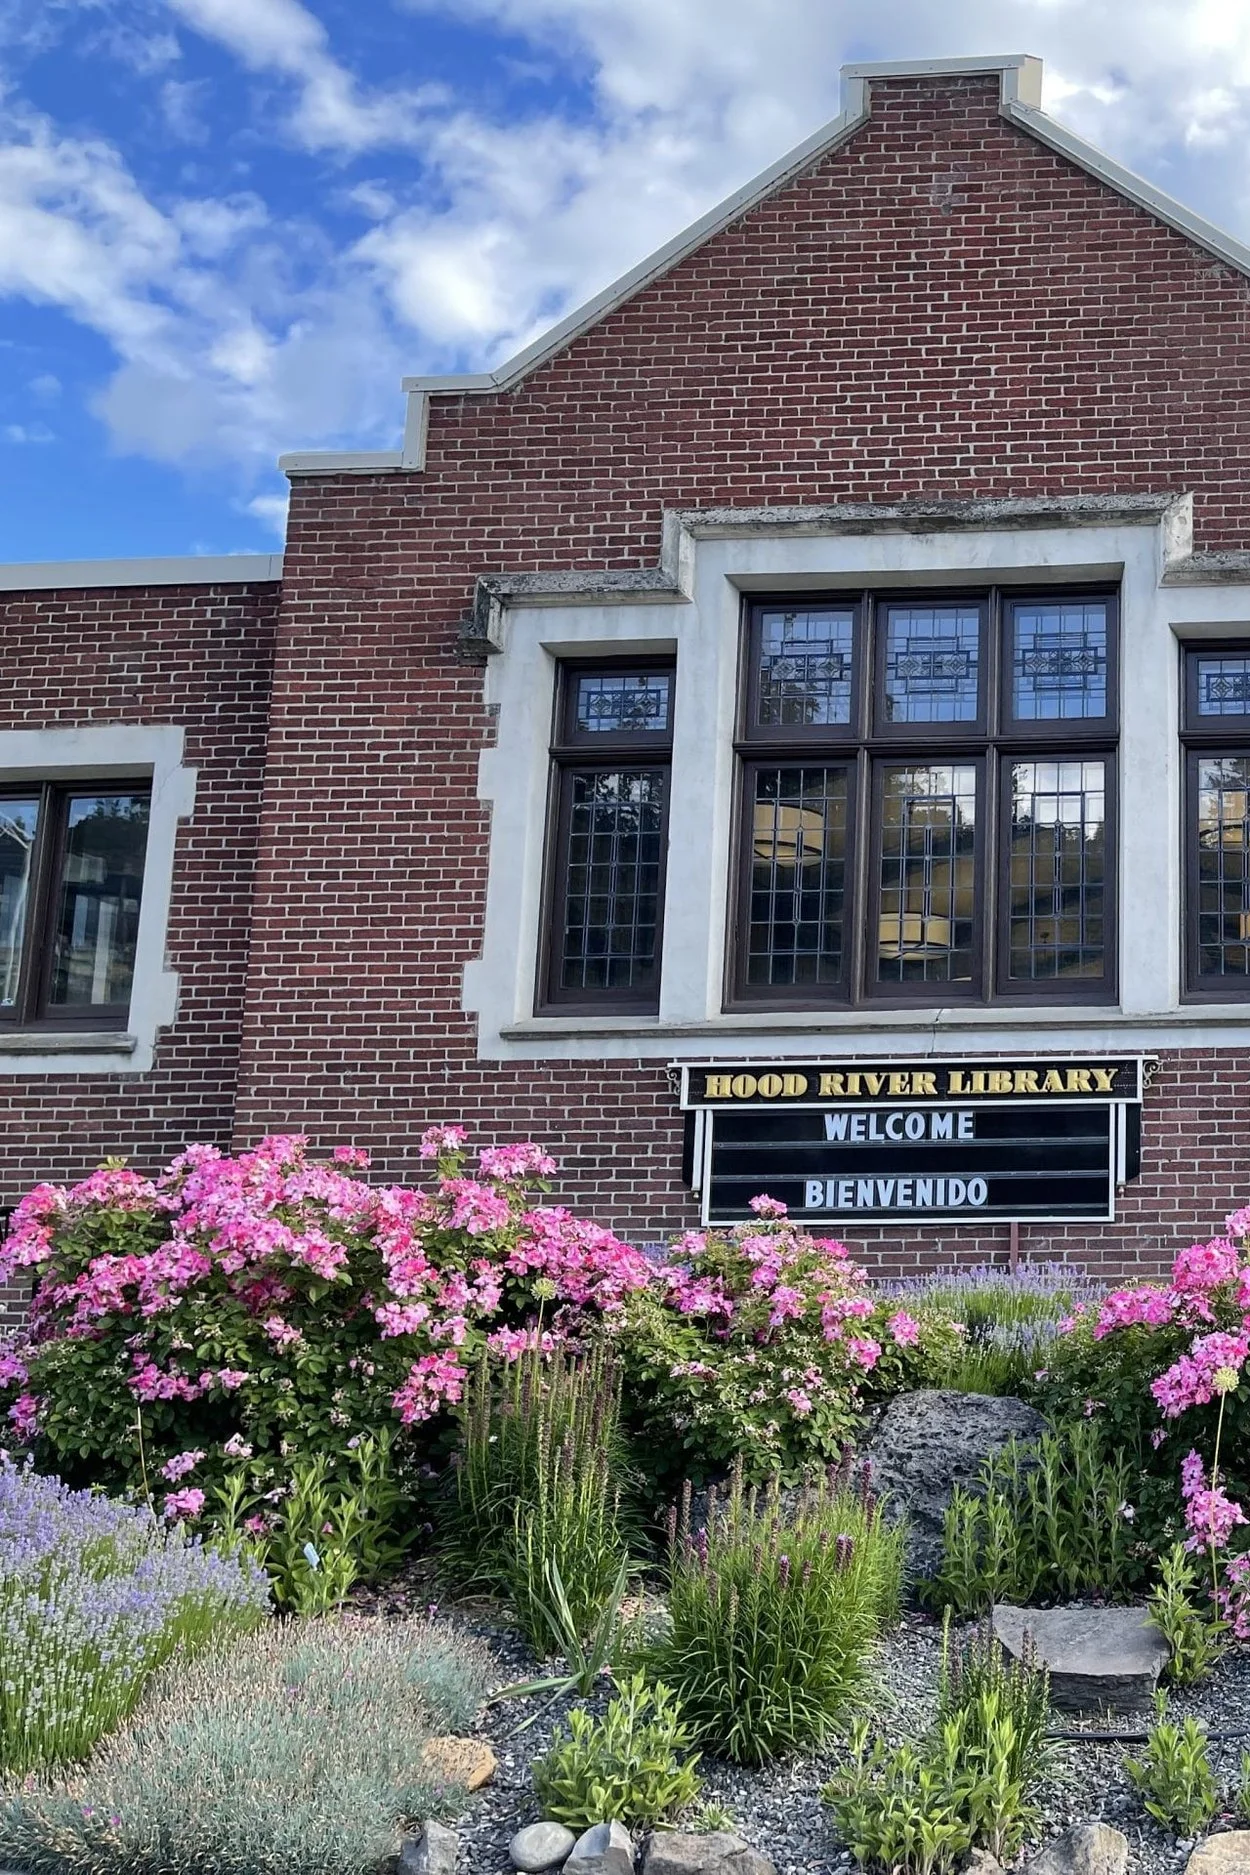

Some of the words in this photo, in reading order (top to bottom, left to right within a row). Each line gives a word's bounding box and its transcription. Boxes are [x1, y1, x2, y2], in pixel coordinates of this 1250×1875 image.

[704, 1073, 808, 1098] HOOD
[818, 1070, 938, 1096] RIVER
[947, 1068, 1119, 1095] LIBRARY
[824, 1111, 974, 1141] WELCOME
[805, 1177, 988, 1208] BIENVENIDO
